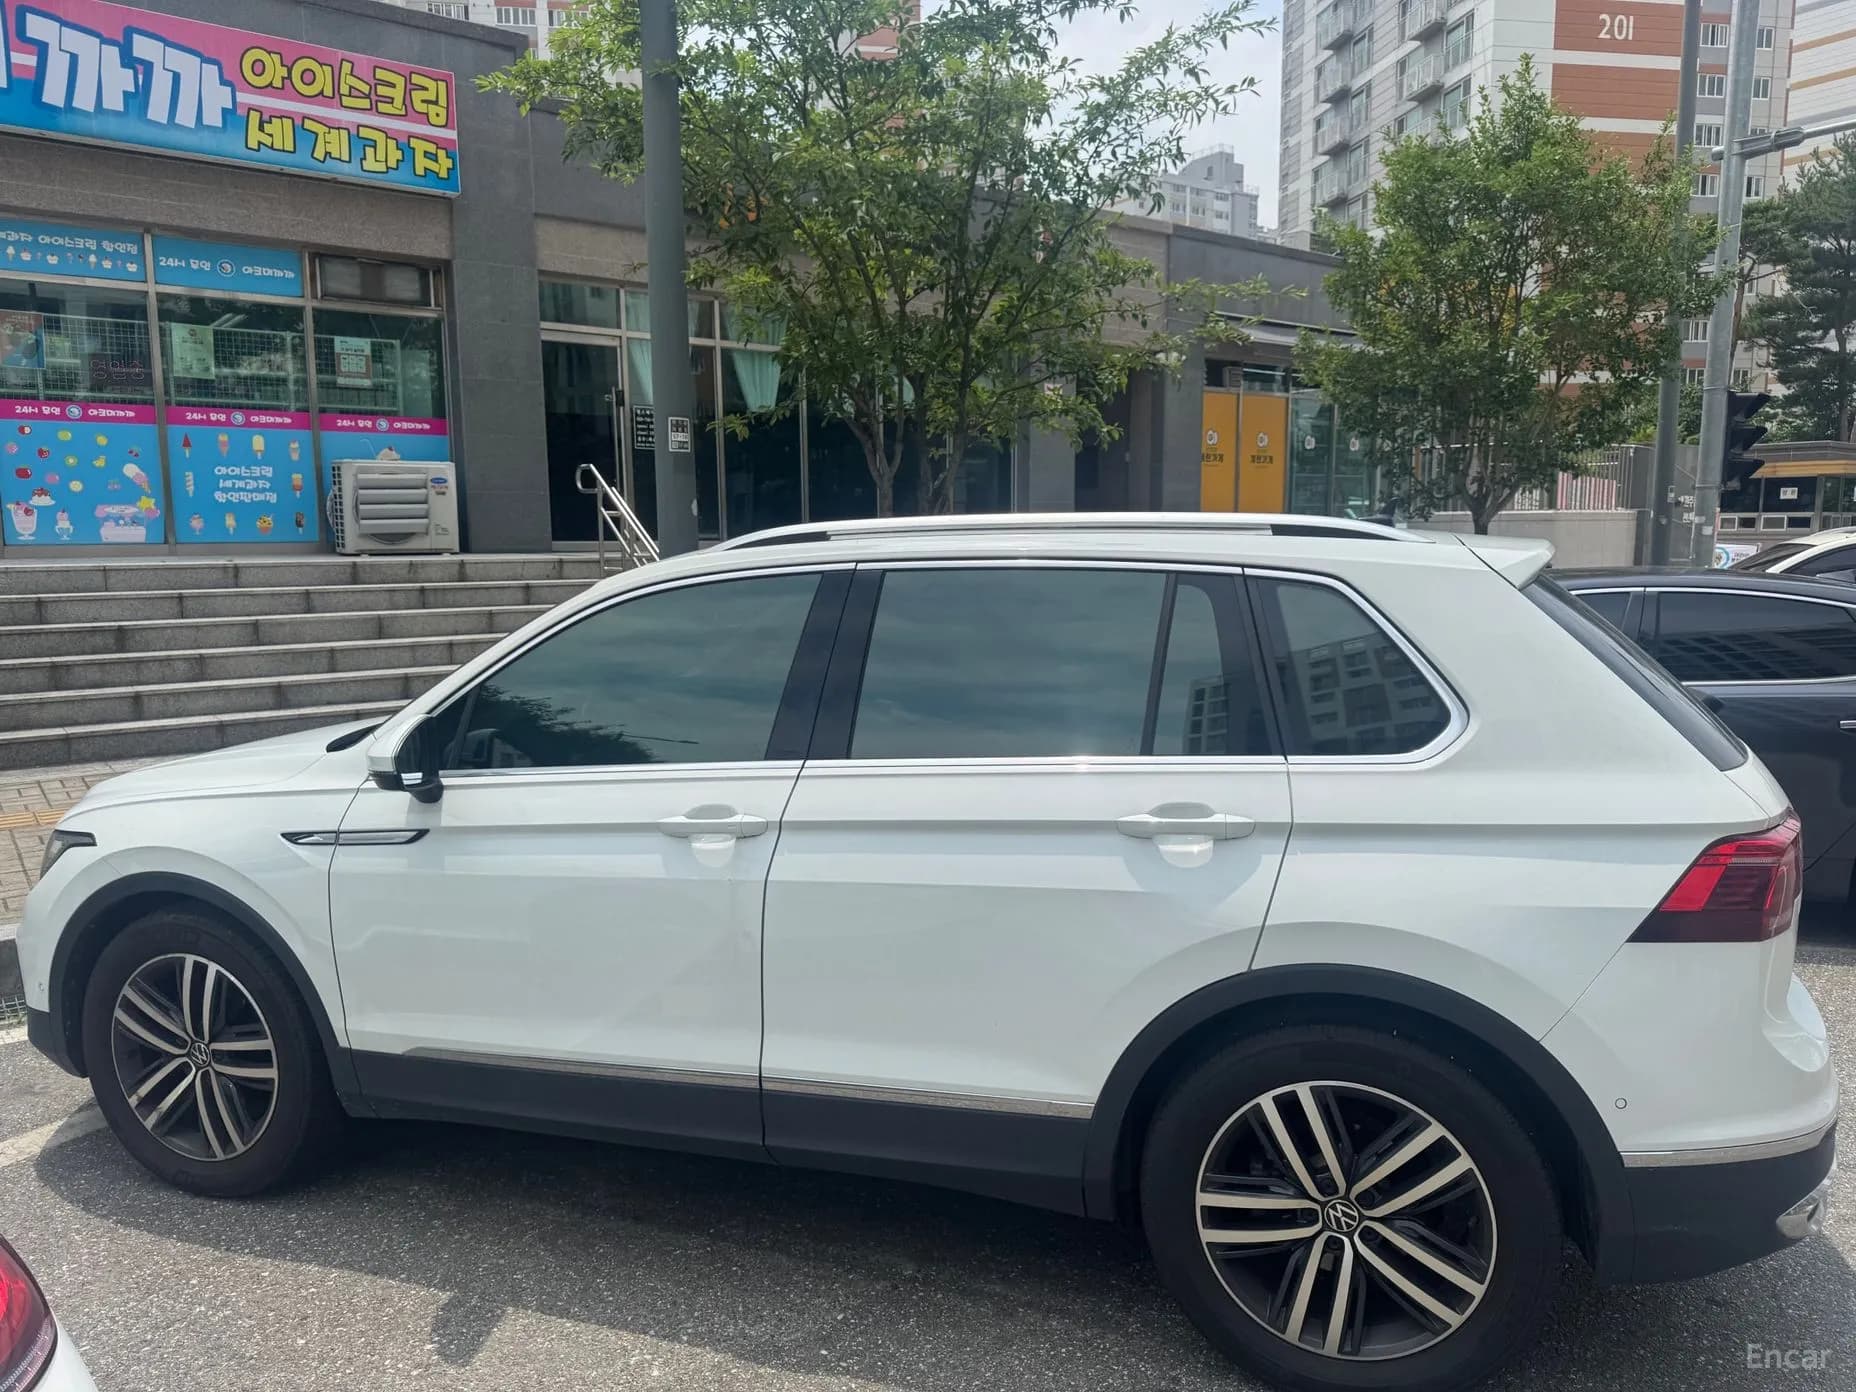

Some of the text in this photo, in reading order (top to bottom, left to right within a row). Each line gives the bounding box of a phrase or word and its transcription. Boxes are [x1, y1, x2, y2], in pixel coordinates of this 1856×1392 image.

[1597, 13, 1634, 40] 201
[240, 46, 449, 127] 아이스크림
[246, 107, 454, 180] 세계과자
[38, 234, 97, 250] 아이스크림
[214, 465, 273, 478] 아이스크림
